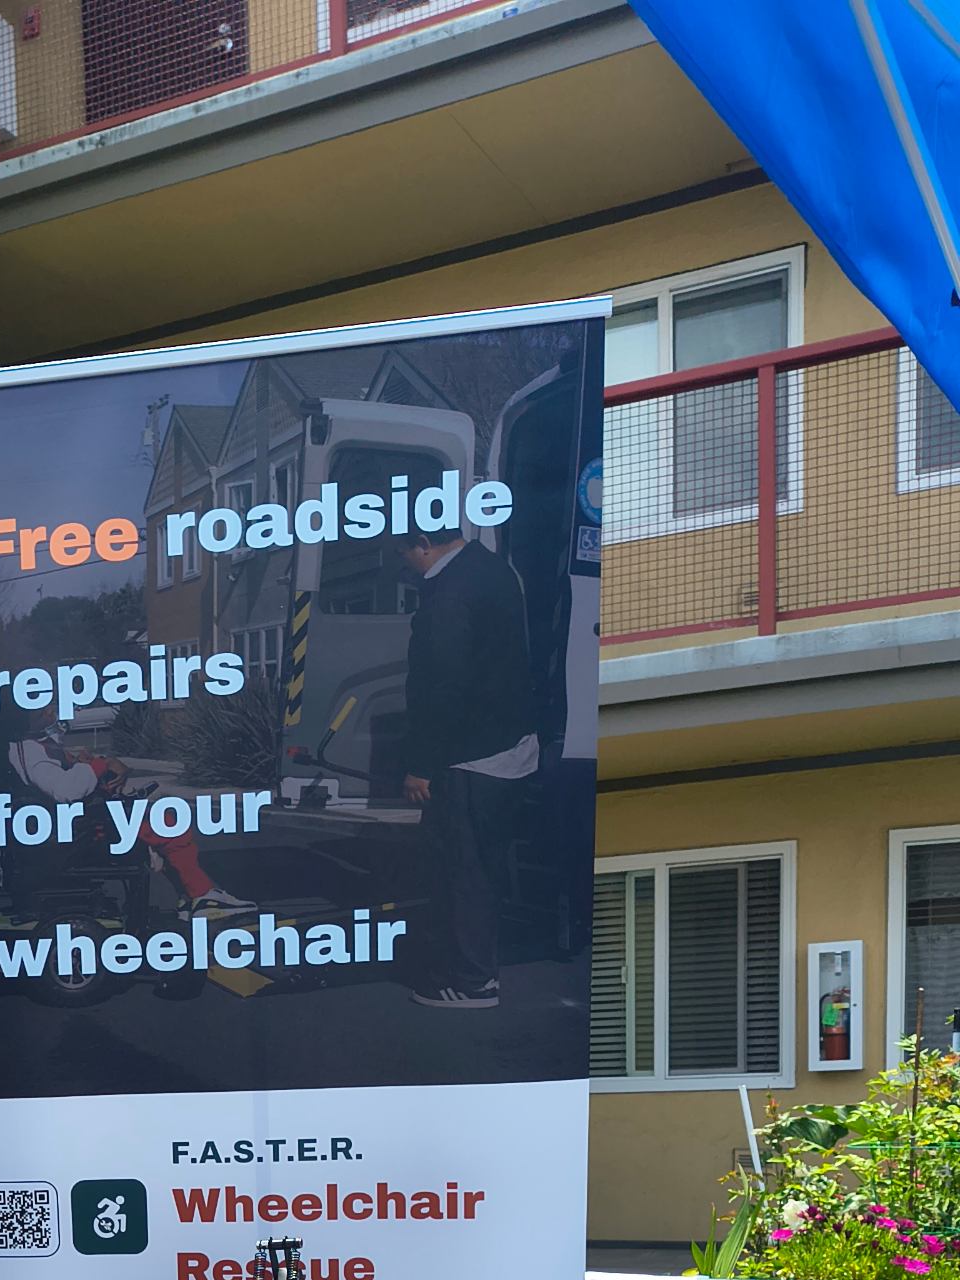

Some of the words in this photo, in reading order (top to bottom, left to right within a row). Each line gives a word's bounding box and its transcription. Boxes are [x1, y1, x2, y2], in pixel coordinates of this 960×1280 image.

[166, 470, 513, 556] roadside
[106, 791, 271, 854] your
[172, 1137, 363, 1164] F.A.S.T.E.R.
[172, 1182, 485, 1223] Wheelchair
